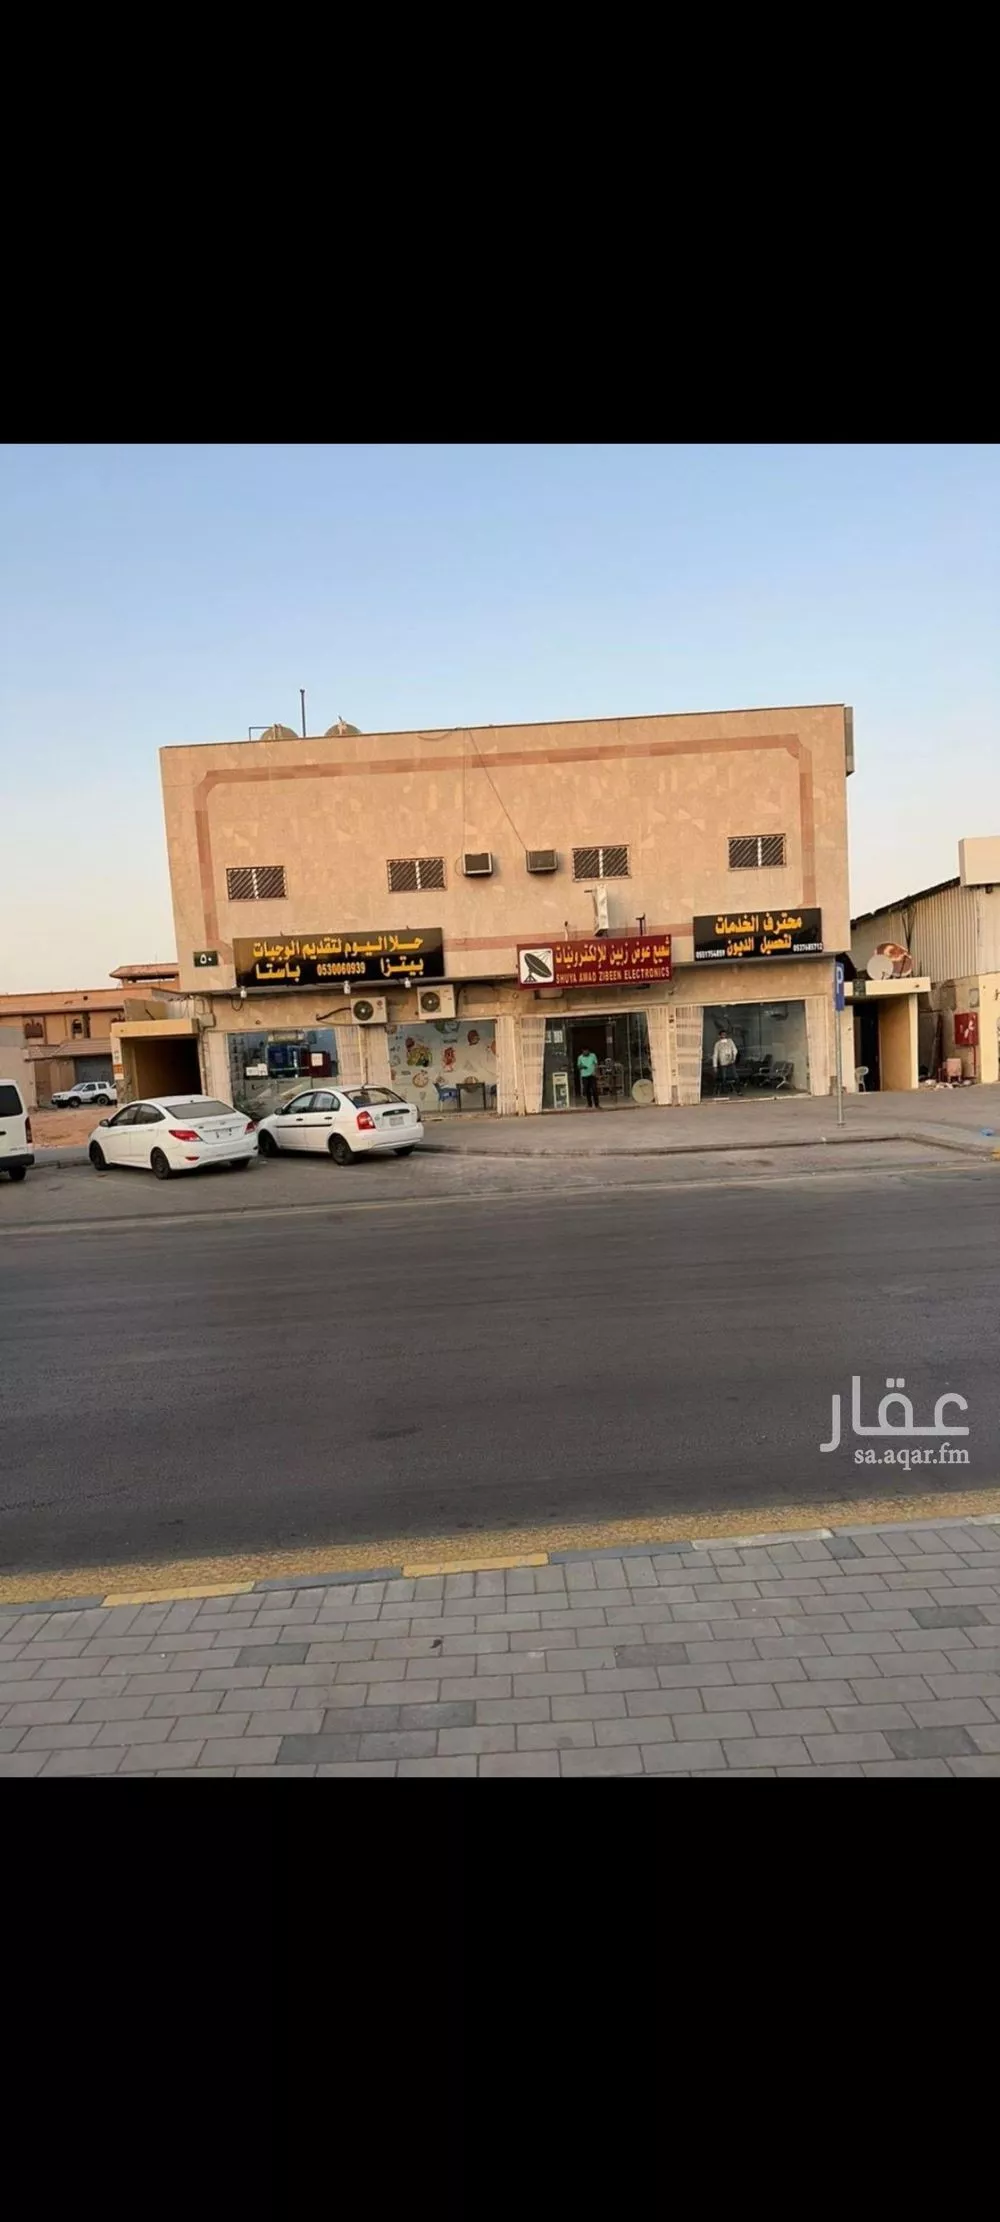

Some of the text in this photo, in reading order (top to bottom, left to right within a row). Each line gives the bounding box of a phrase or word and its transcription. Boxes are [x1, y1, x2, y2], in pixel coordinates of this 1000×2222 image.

[715, 912, 802, 935] محترف الخدمات
[253, 940, 300, 962] الوجبات
[302, 937, 342, 960] لتقديم
[344, 936, 388, 959] اليوم
[555, 943, 607, 969] للإلكترونيات
[609, 942, 629, 966] زبين
[631, 941, 650, 965] عوض
[726, 936, 754, 957] الديون
[255, 956, 425, 982] بيتزا 0530060939 باستا
[556, 966, 670, 984] SHUYA AWAD ZIBEEN ELECTRONICS
[836, 966, 844, 994] P
